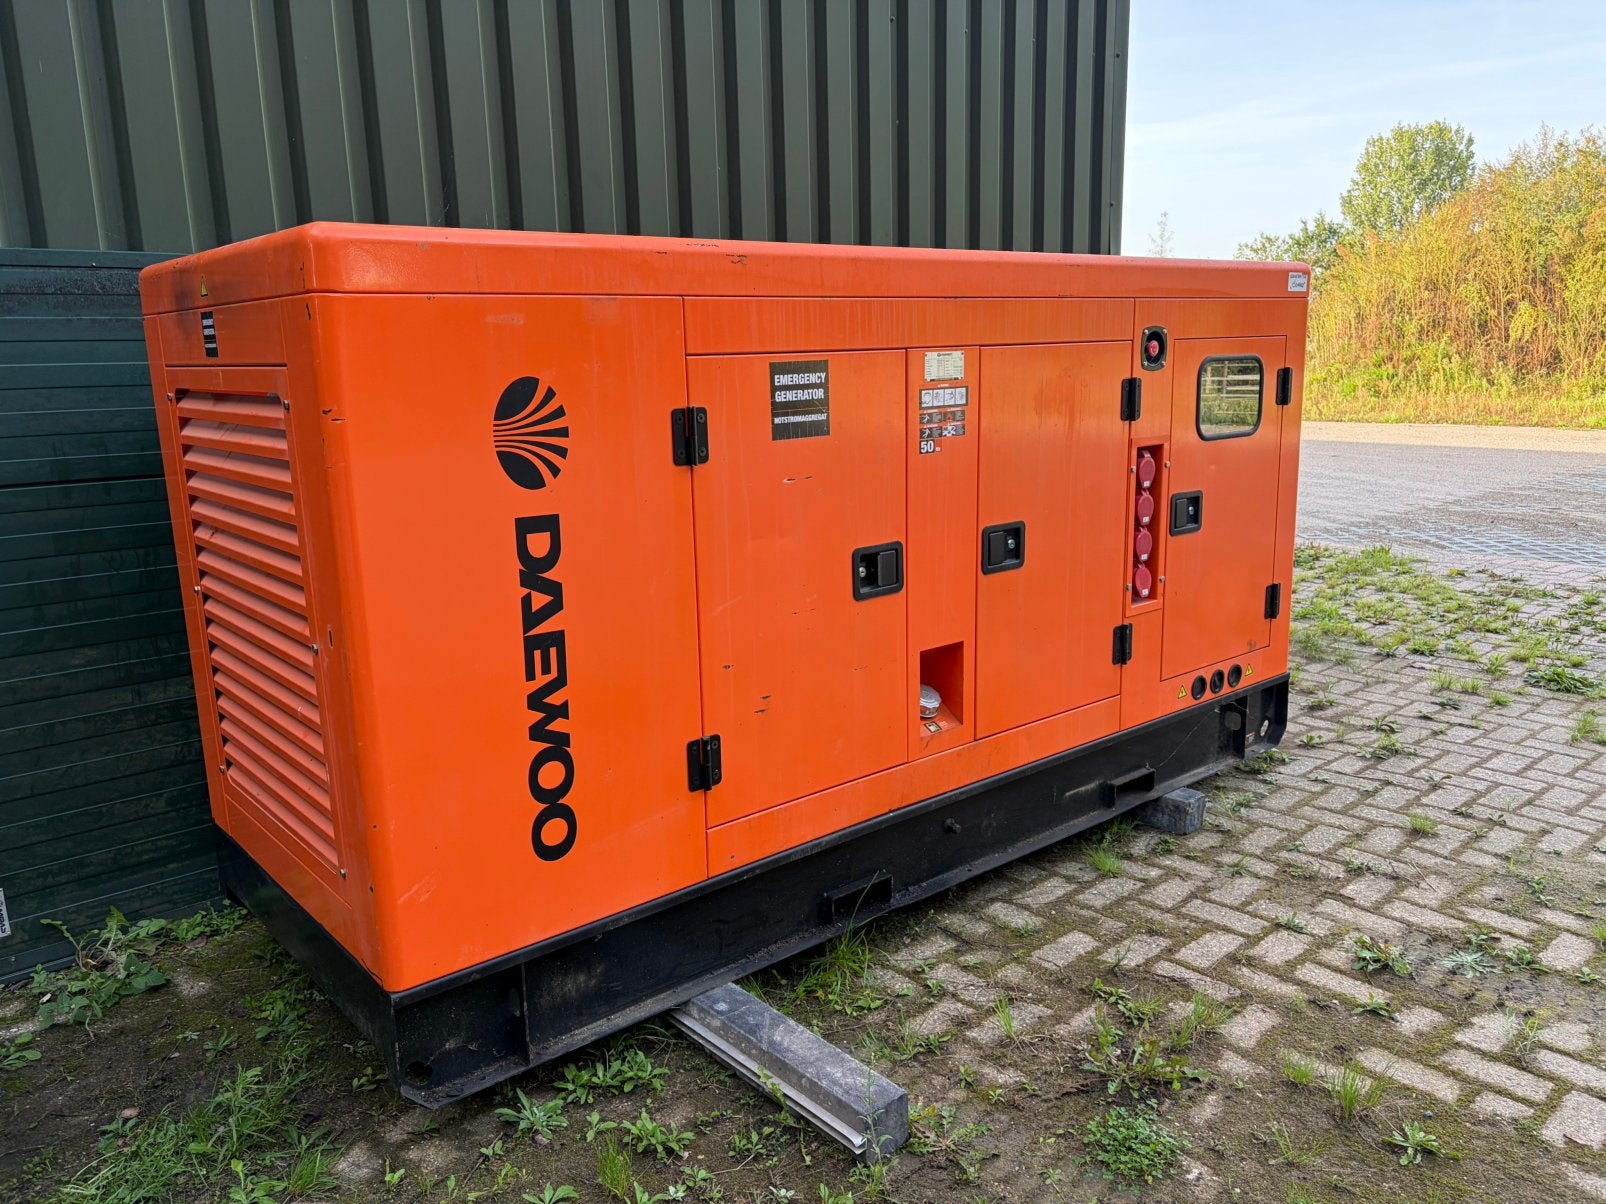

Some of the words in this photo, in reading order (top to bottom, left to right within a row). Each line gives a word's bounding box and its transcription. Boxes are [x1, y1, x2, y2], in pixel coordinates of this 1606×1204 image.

[774, 372, 826, 386] EMERGENCY
[775, 388, 824, 402] GENERATOR
[920, 440, 934, 453] 50
[514, 513, 577, 862] DAEWOO
